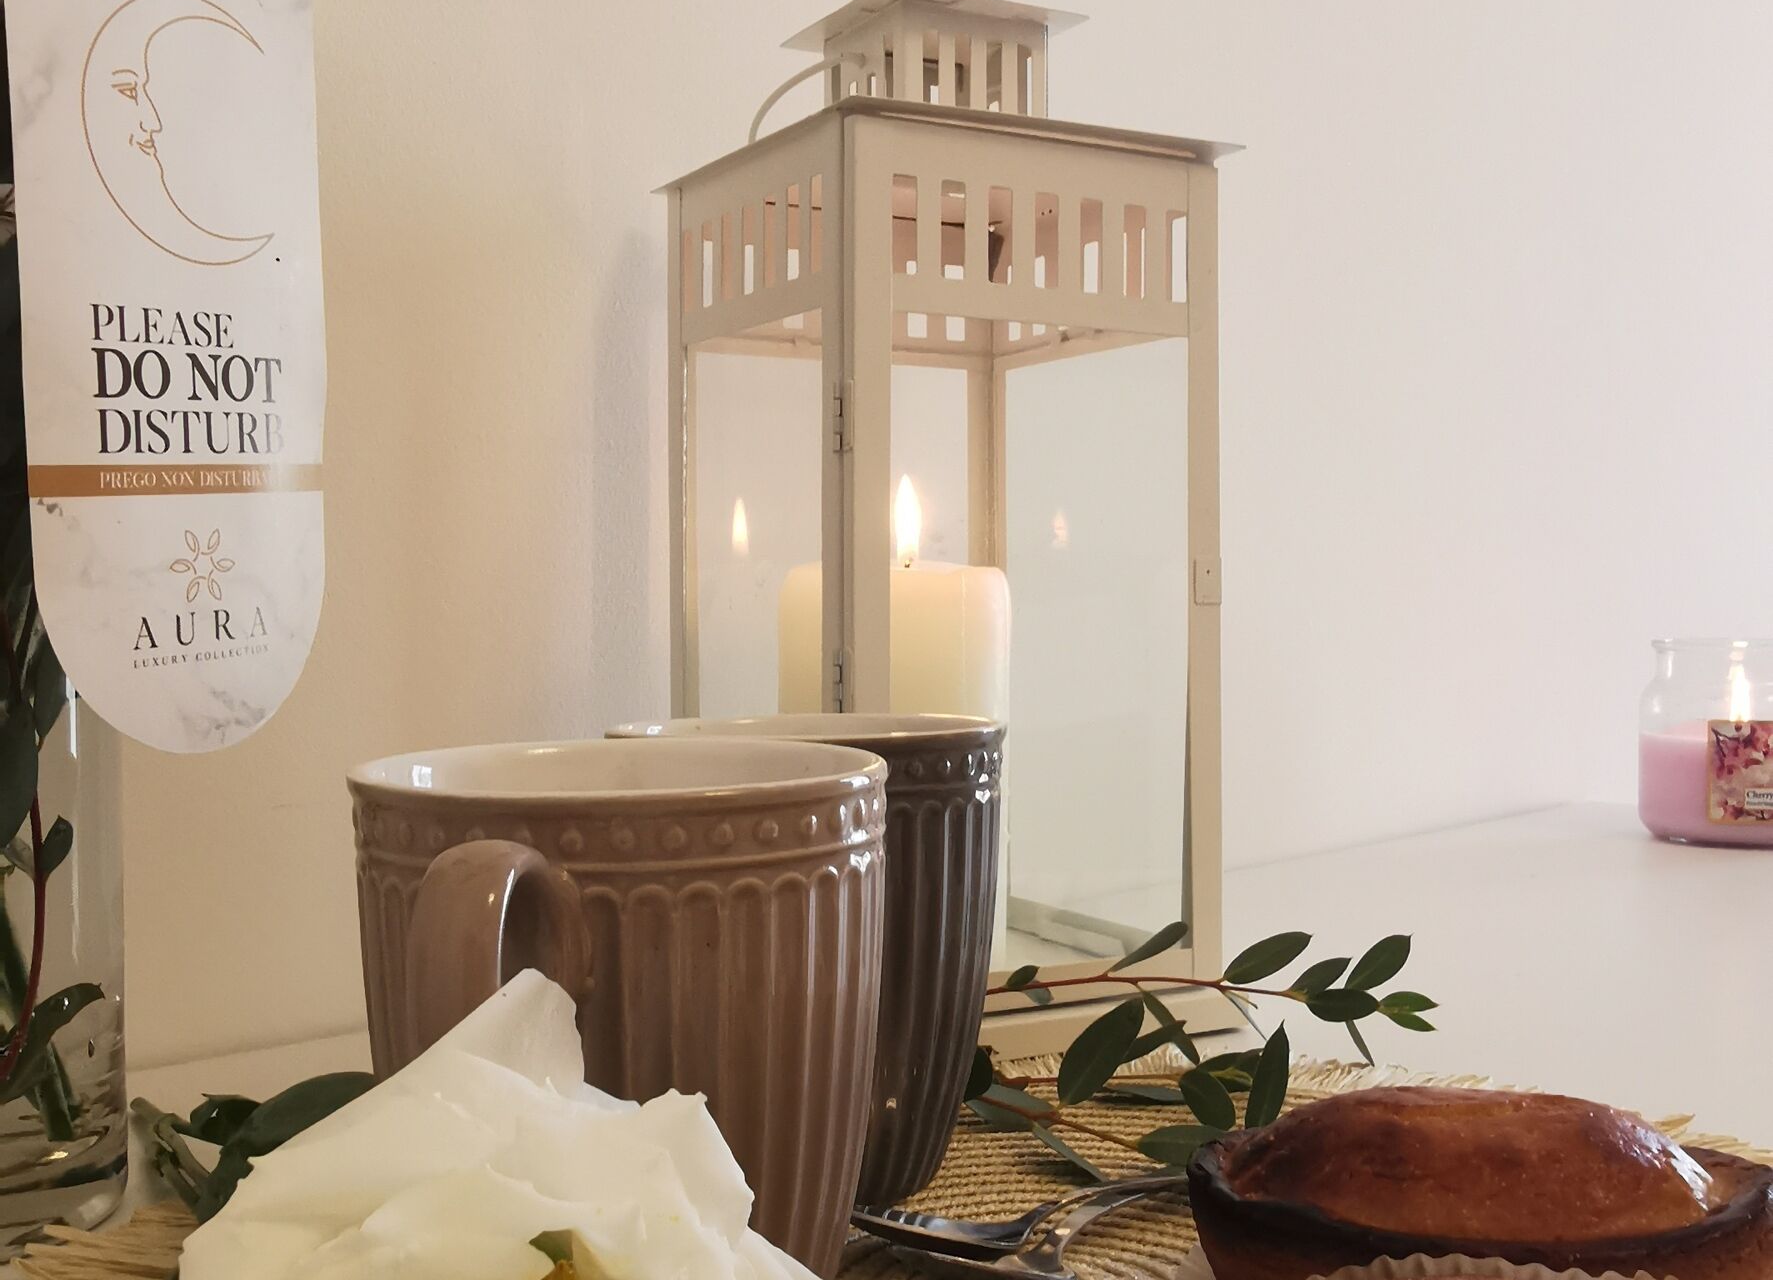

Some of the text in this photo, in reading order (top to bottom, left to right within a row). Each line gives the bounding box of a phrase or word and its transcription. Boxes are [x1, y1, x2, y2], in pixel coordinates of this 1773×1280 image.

[89, 302, 234, 349] PLEASE
[90, 347, 282, 404] DO NOT
[97, 408, 284, 454] DISTURB
[99, 471, 157, 489] PREGO
[161, 471, 195, 488] NON
[132, 606, 268, 651] AURA
[132, 643, 270, 670] LUXURY COLLECTION
